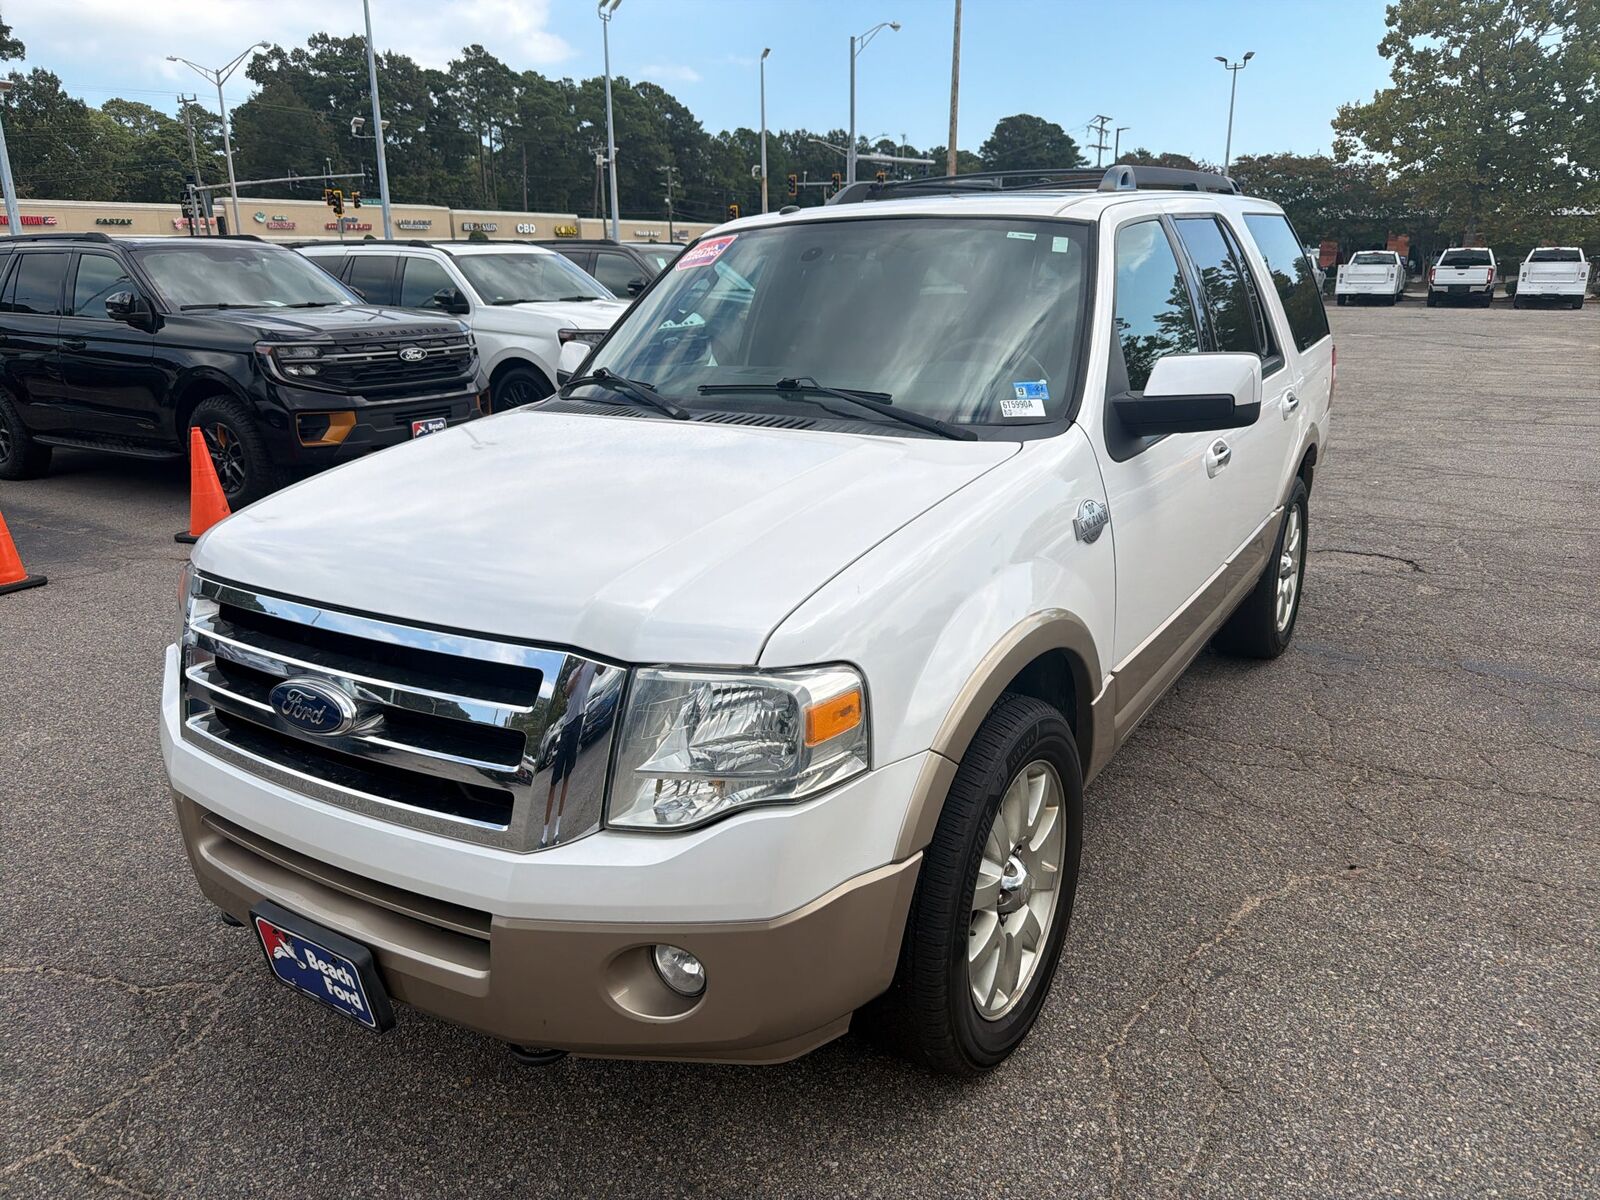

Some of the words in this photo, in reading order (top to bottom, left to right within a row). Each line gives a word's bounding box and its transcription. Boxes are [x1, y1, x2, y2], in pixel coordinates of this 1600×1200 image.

[517, 223, 536, 234] CBD
[555, 225, 577, 235] COINS
[405, 350, 423, 360] Ford
[1018, 387, 1025, 396] 9
[281, 688, 327, 725] Ford
[304, 948, 357, 990] Beach
[323, 976, 365, 1012] Ford
